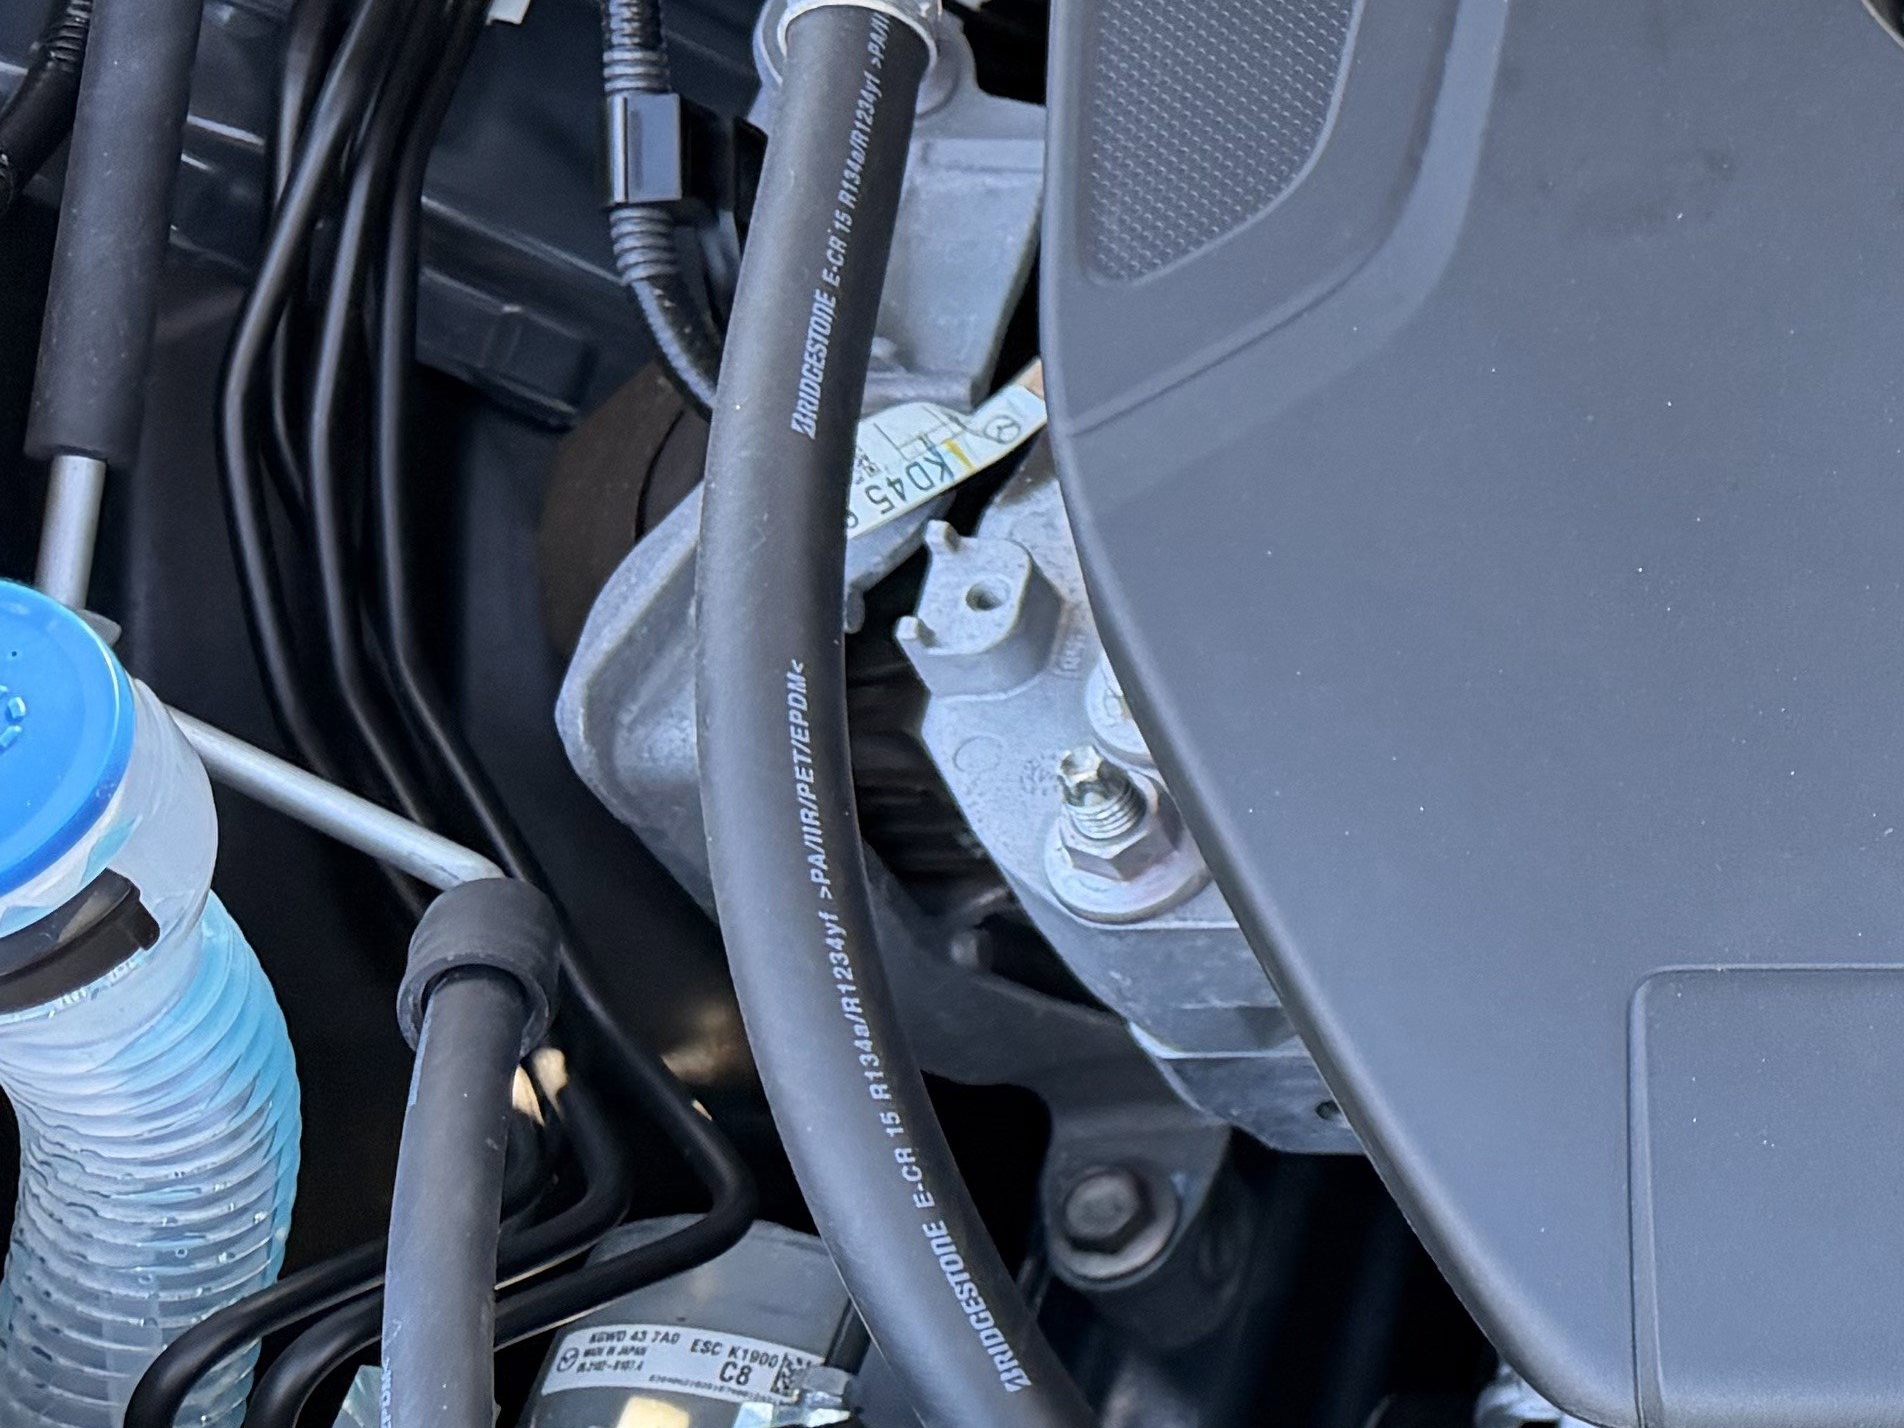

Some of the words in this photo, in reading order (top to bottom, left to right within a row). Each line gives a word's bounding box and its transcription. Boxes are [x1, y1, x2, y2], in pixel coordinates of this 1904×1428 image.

[791, 289, 836, 440] BRIDGESTONE
[833, 209, 854, 236] 15
[818, 910, 893, 1101] R134a/R1234yf
[880, 1110, 904, 1137] 15
[718, 1360, 753, 1386] C8
[922, 1220, 1032, 1393] BRIDGESTONE
